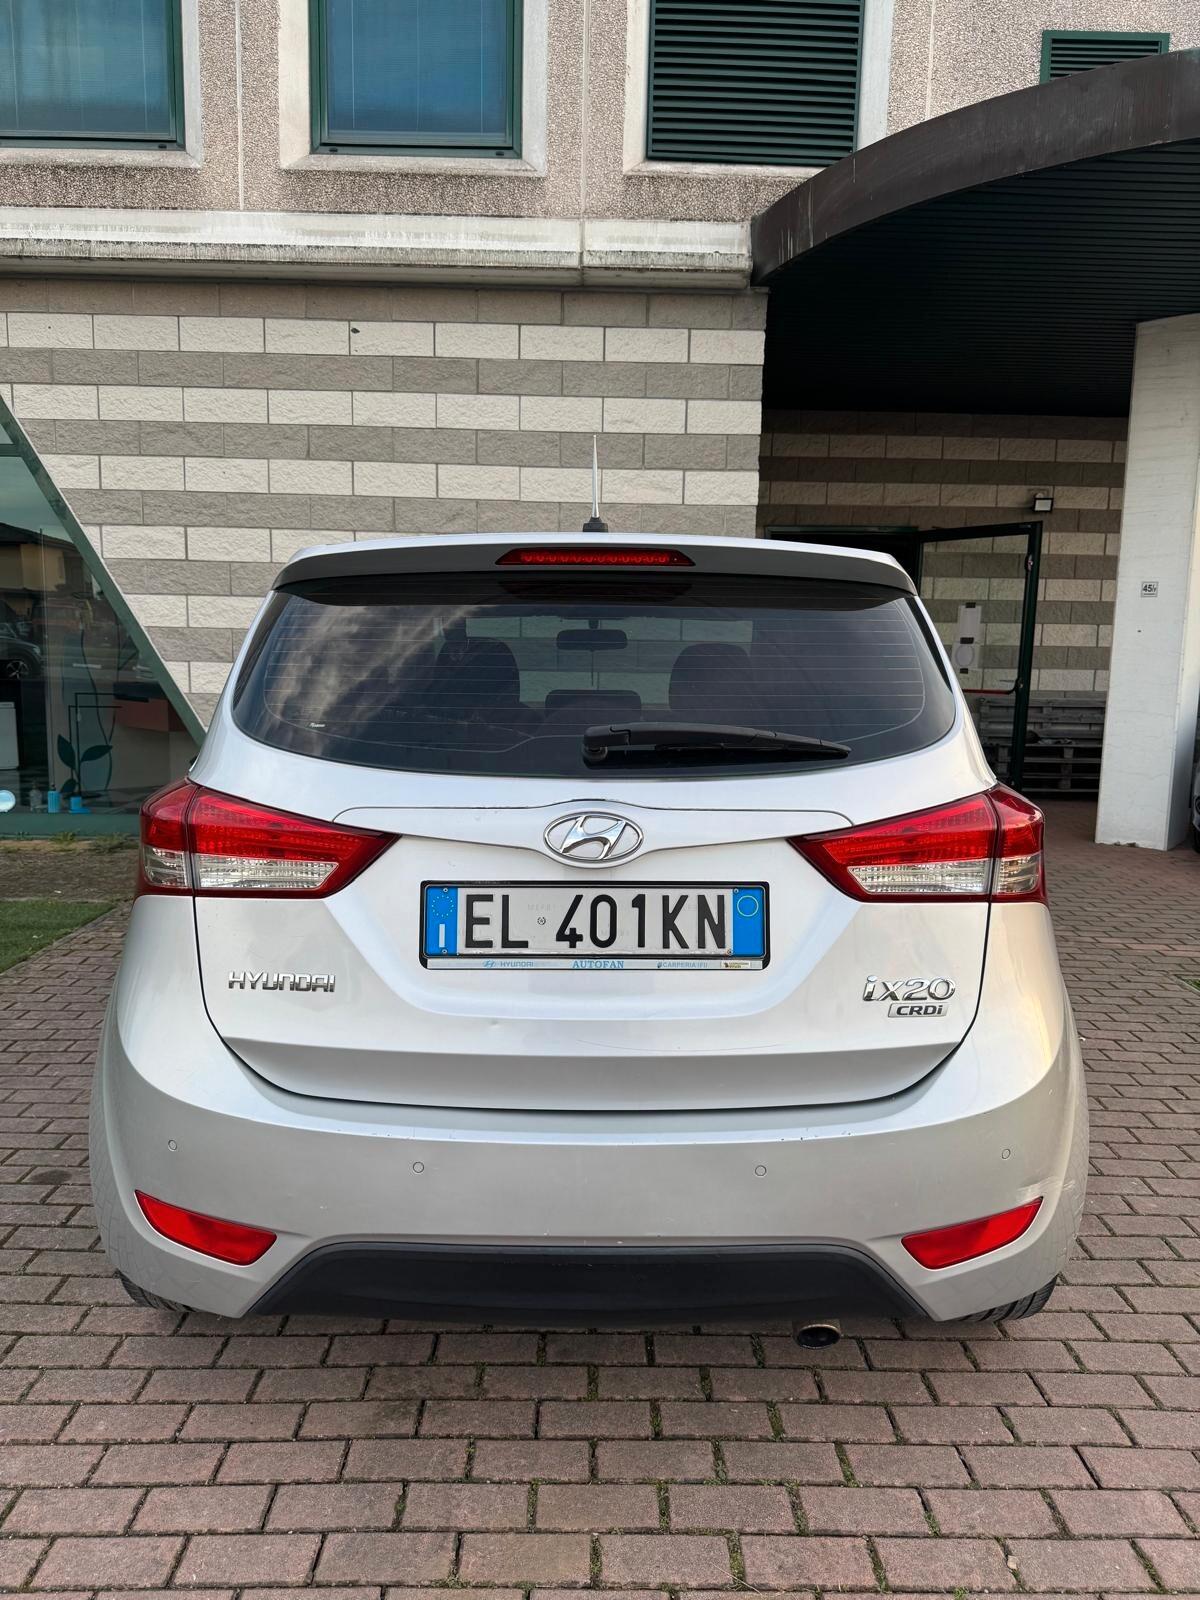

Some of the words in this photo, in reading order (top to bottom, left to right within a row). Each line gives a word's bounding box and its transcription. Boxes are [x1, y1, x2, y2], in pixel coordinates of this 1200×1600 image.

[465, 894, 529, 949] EL
[555, 893, 726, 949] 401KN
[572, 960, 625, 969] AUTOFAN
[228, 971, 336, 993] HYUNDAI
[862, 975, 956, 1002] ix20
[896, 1005, 943, 1016] CRDi
